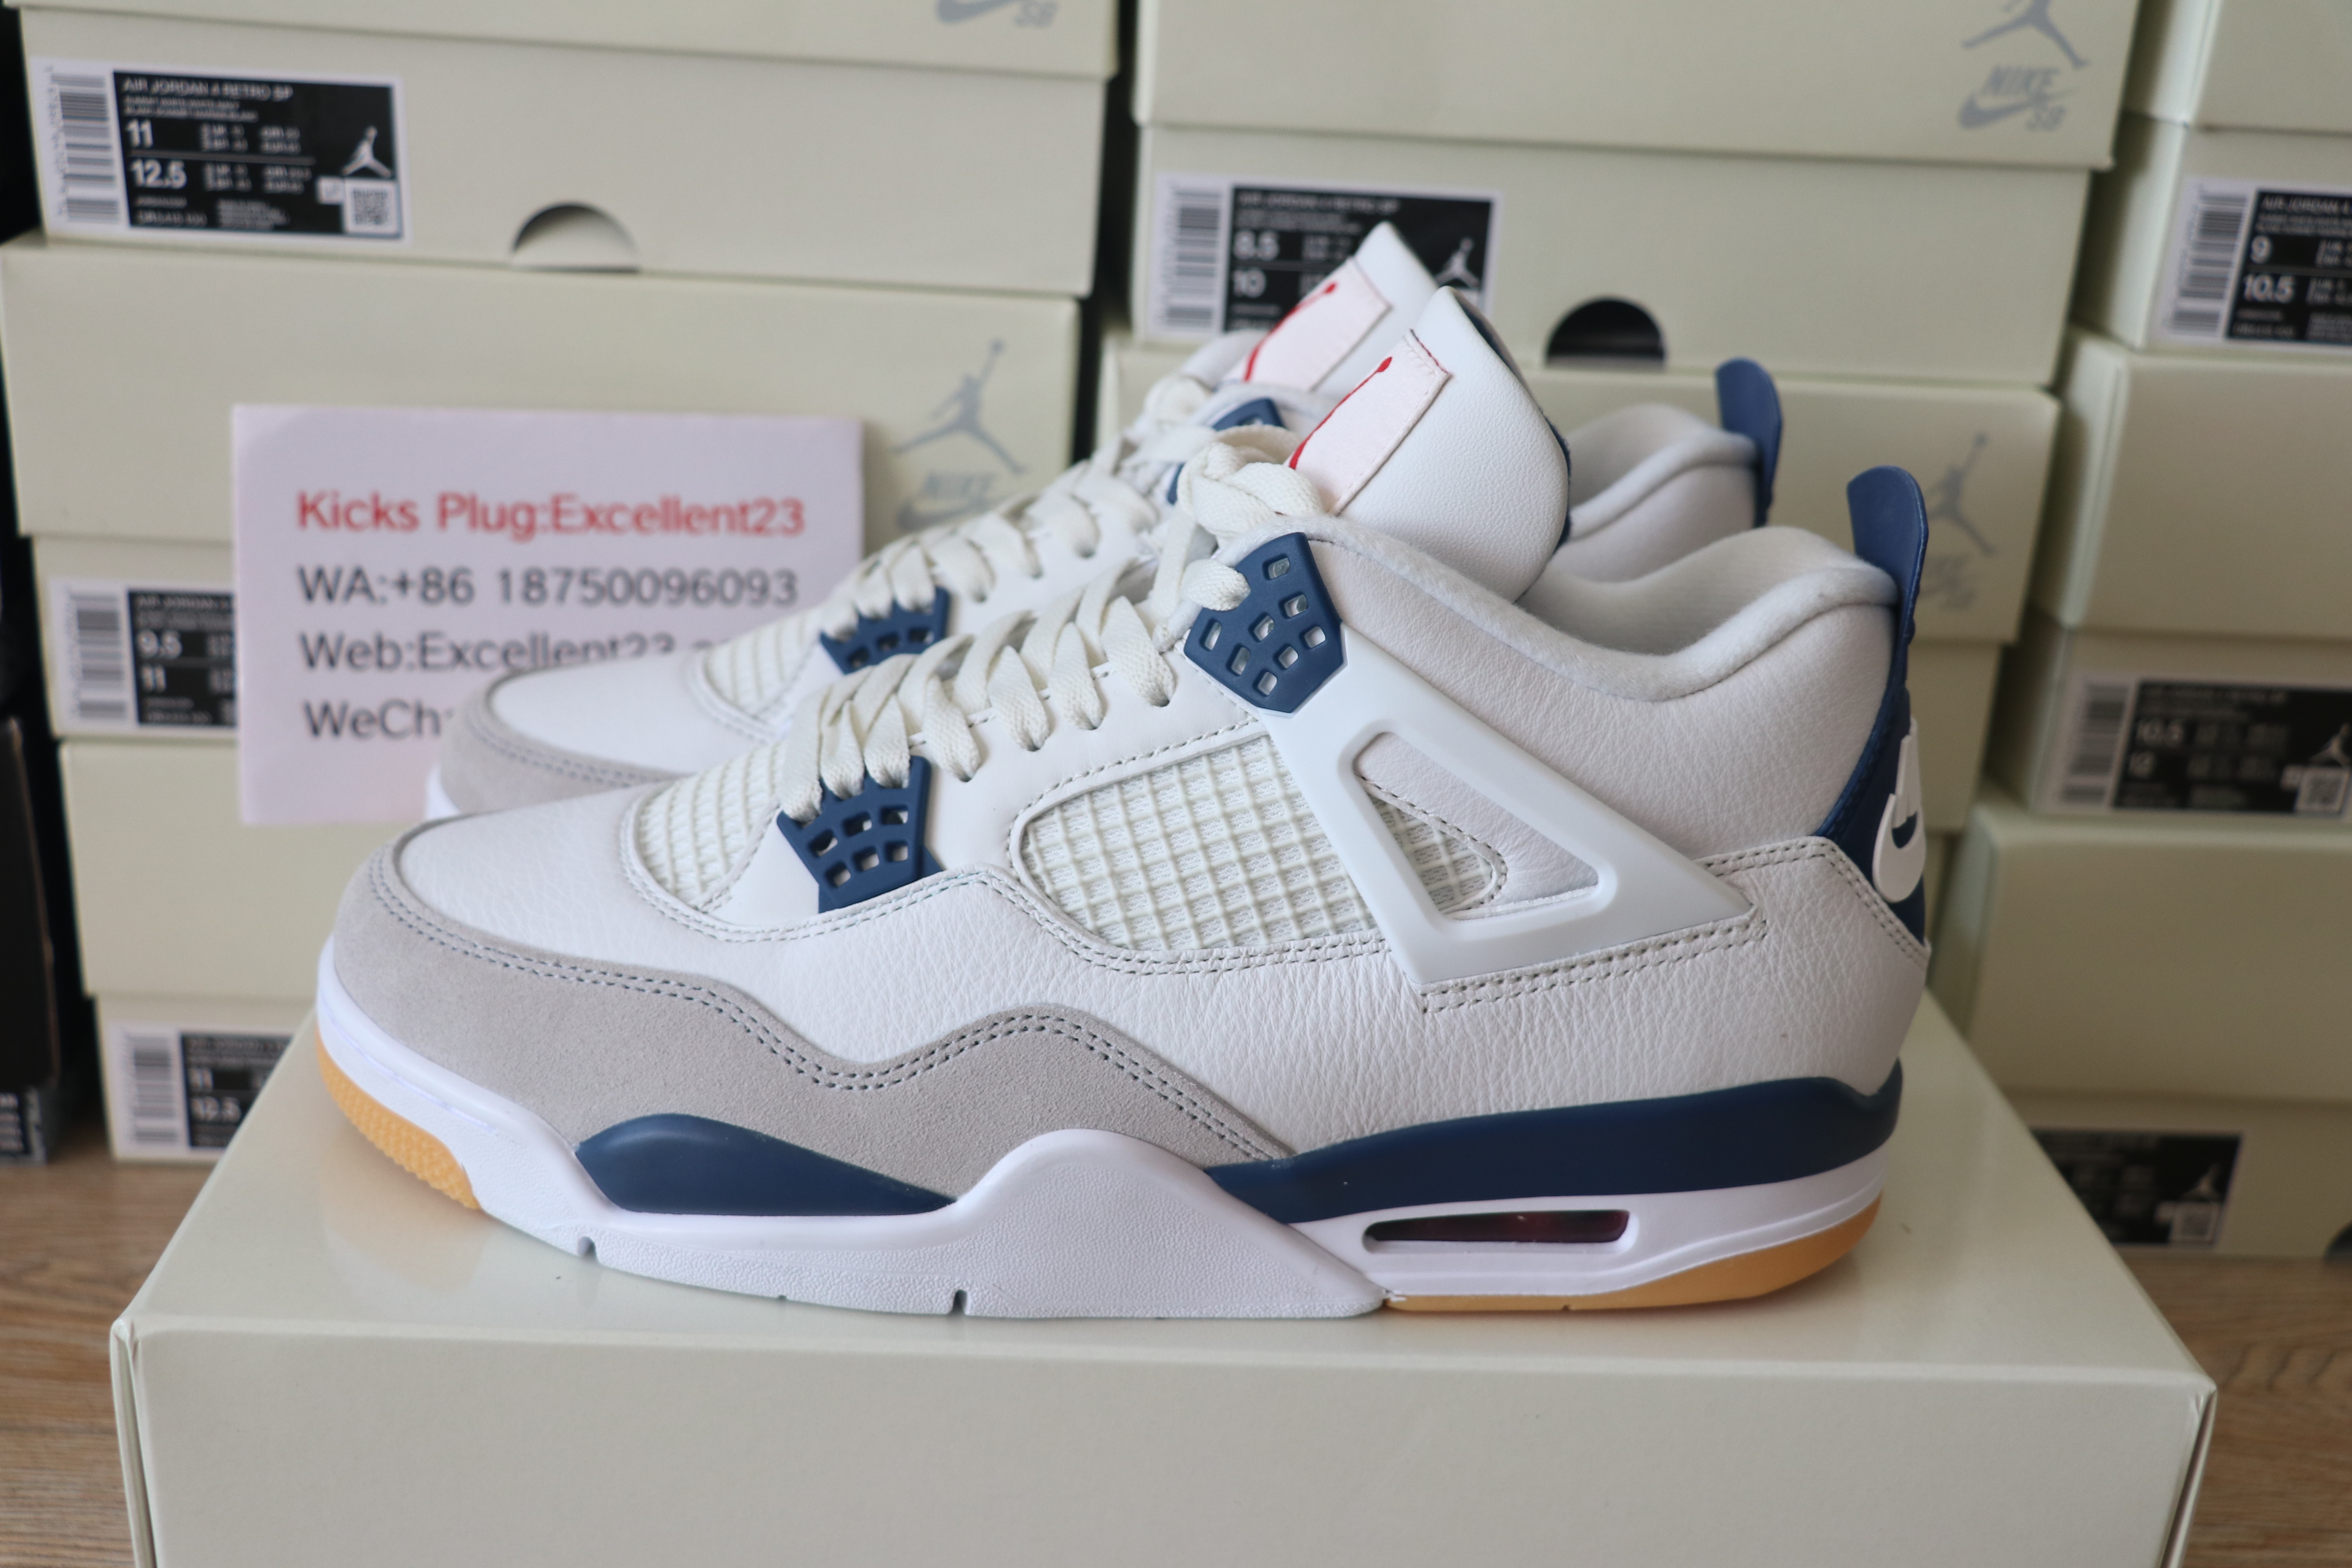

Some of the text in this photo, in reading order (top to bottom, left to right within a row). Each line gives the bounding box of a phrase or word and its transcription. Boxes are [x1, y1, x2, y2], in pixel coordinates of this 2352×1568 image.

[123, 77, 149, 93] AIR
[151, 80, 209, 96] JORDAN
[222, 82, 272, 101] RETRO
[1982, 65, 2061, 95] NIKE
[125, 118, 154, 149] 11
[130, 158, 187, 190] 12.5
[1233, 230, 1279, 261] 8.5
[2250, 235, 2271, 264] 9
[1232, 267, 1266, 299] 10
[2243, 274, 2296, 304] 10.5
[297, 491, 805, 544] Kicks Plug:Excellent23
[297, 565, 799, 607] WA:+86 18750096093
[138, 629, 183, 659] 9.5
[299, 630, 714, 672] Web:Excellent23
[140, 664, 167, 693] 11
[303, 699, 454, 740] WeCh
